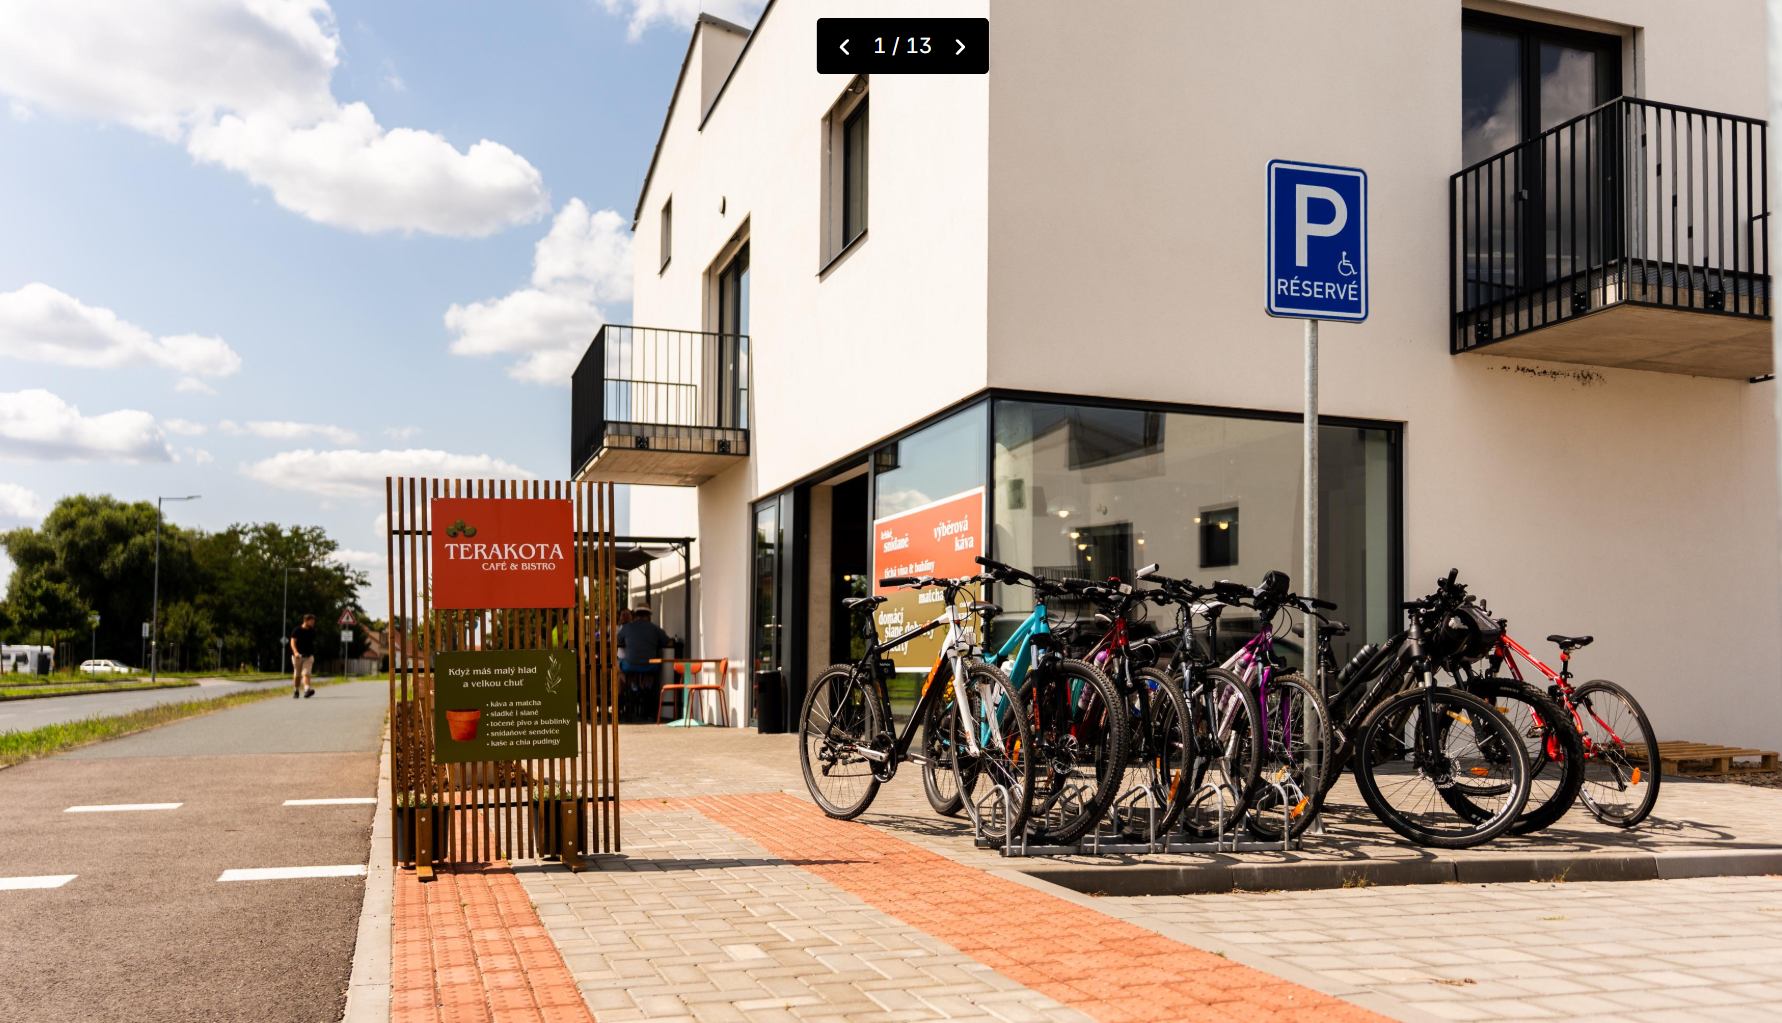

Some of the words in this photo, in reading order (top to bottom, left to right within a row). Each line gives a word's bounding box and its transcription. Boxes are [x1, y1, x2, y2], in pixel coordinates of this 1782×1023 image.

[1295, 183, 1348, 267] P
[1277, 276, 1359, 301] RÉSERVÉ
[933, 514, 969, 542] výběrová
[954, 534, 974, 551] káva
[444, 543, 564, 560] TERAKOTA
[482, 561, 507, 571] CAFÉ
[510, 563, 518, 571] &
[521, 562, 556, 571] BISTRO
[918, 588, 944, 604] matcha
[878, 607, 904, 625] domácí
[448, 667, 471, 678] Když
[473, 667, 492, 675] máš
[494, 666, 516, 676] malý
[517, 666, 537, 674] hlad
[471, 679, 501, 688] velkou
[503, 679, 525, 687] chuť
[490, 719, 515, 727] točené
[516, 719, 532, 727] pivo
[540, 718, 571, 726] bublinky
[490, 729, 527, 737] snídaňové
[528, 728, 560, 736] sendviče
[490, 739, 508, 747] kaše
[532, 738, 561, 747] pudingy
